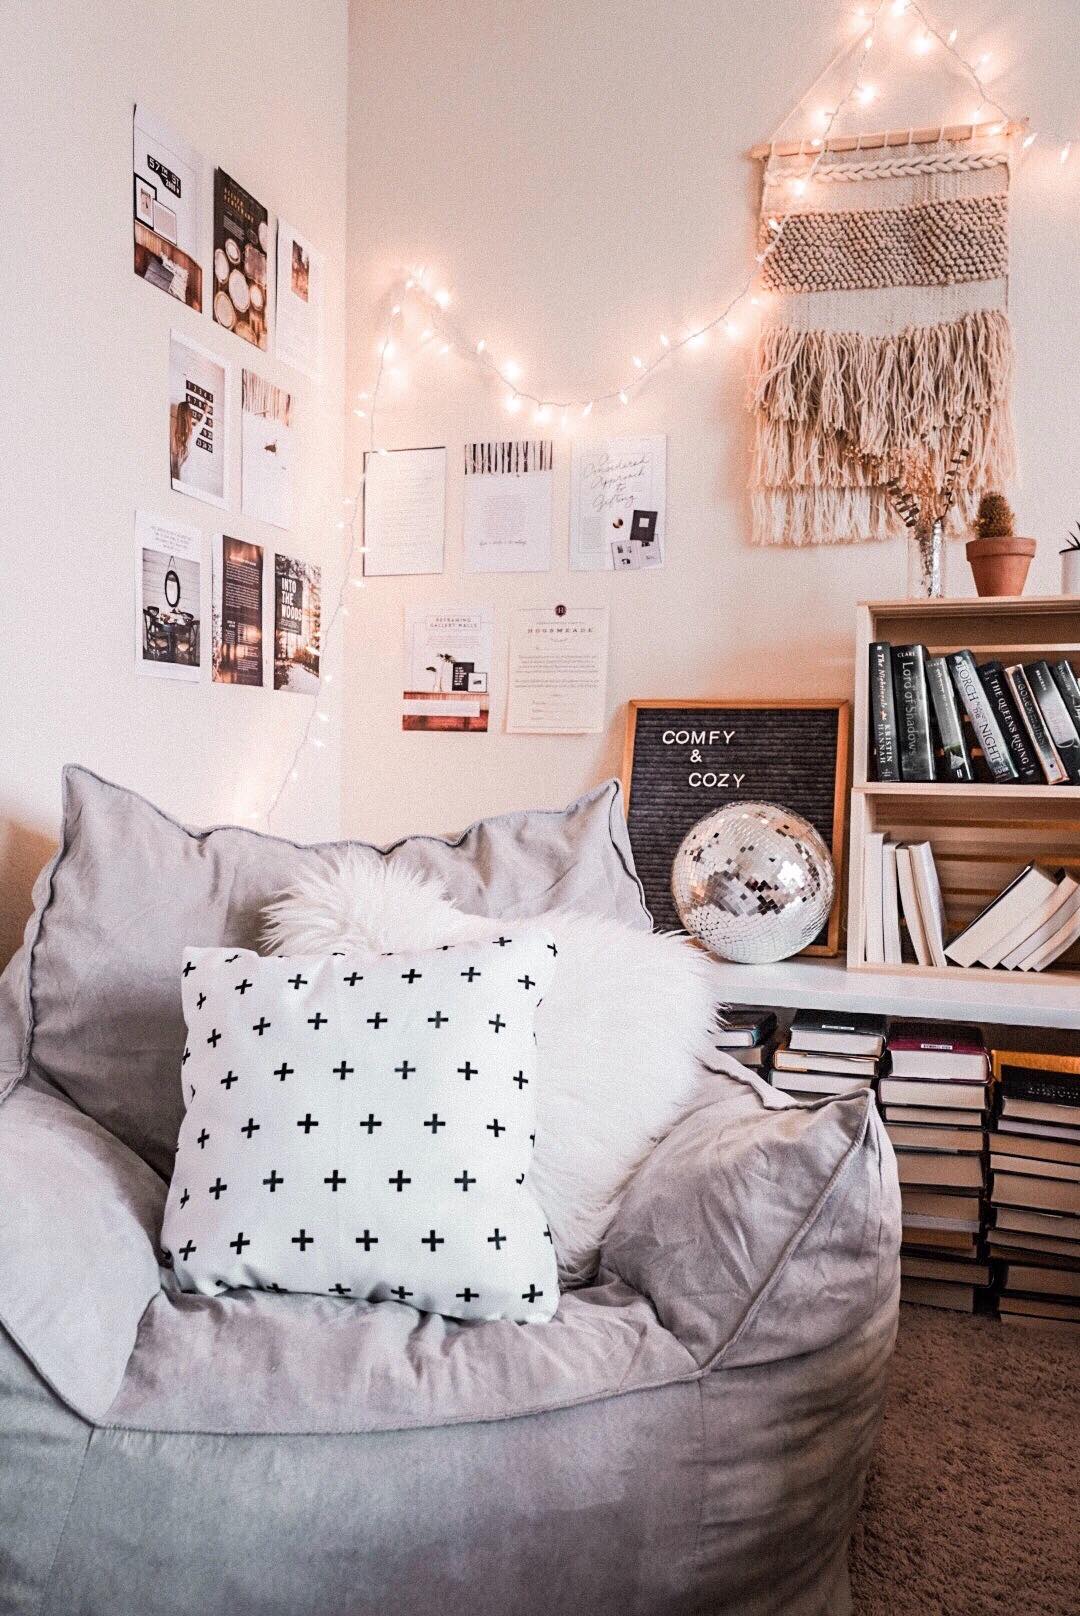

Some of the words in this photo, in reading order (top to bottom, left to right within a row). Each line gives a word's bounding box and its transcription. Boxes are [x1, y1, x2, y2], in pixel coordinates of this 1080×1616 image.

[281, 578, 296, 593] INTO
[281, 592, 293, 606] THE
[280, 604, 302, 621] WOODS
[877, 653, 885, 667] The
[902, 662, 914, 689] Lord
[956, 661, 979, 702] TORCH
[905, 705, 918, 756] Shadows
[991, 680, 1002, 698] THE
[1011, 734, 1031, 766] RISING
[662, 730, 735, 745] COMFY
[877, 724, 886, 764] HANNAH
[884, 724, 893, 762] KRISTIN
[980, 722, 1004, 763] NIGHT
[690, 749, 702, 763] &
[688, 772, 745, 788] COZY
